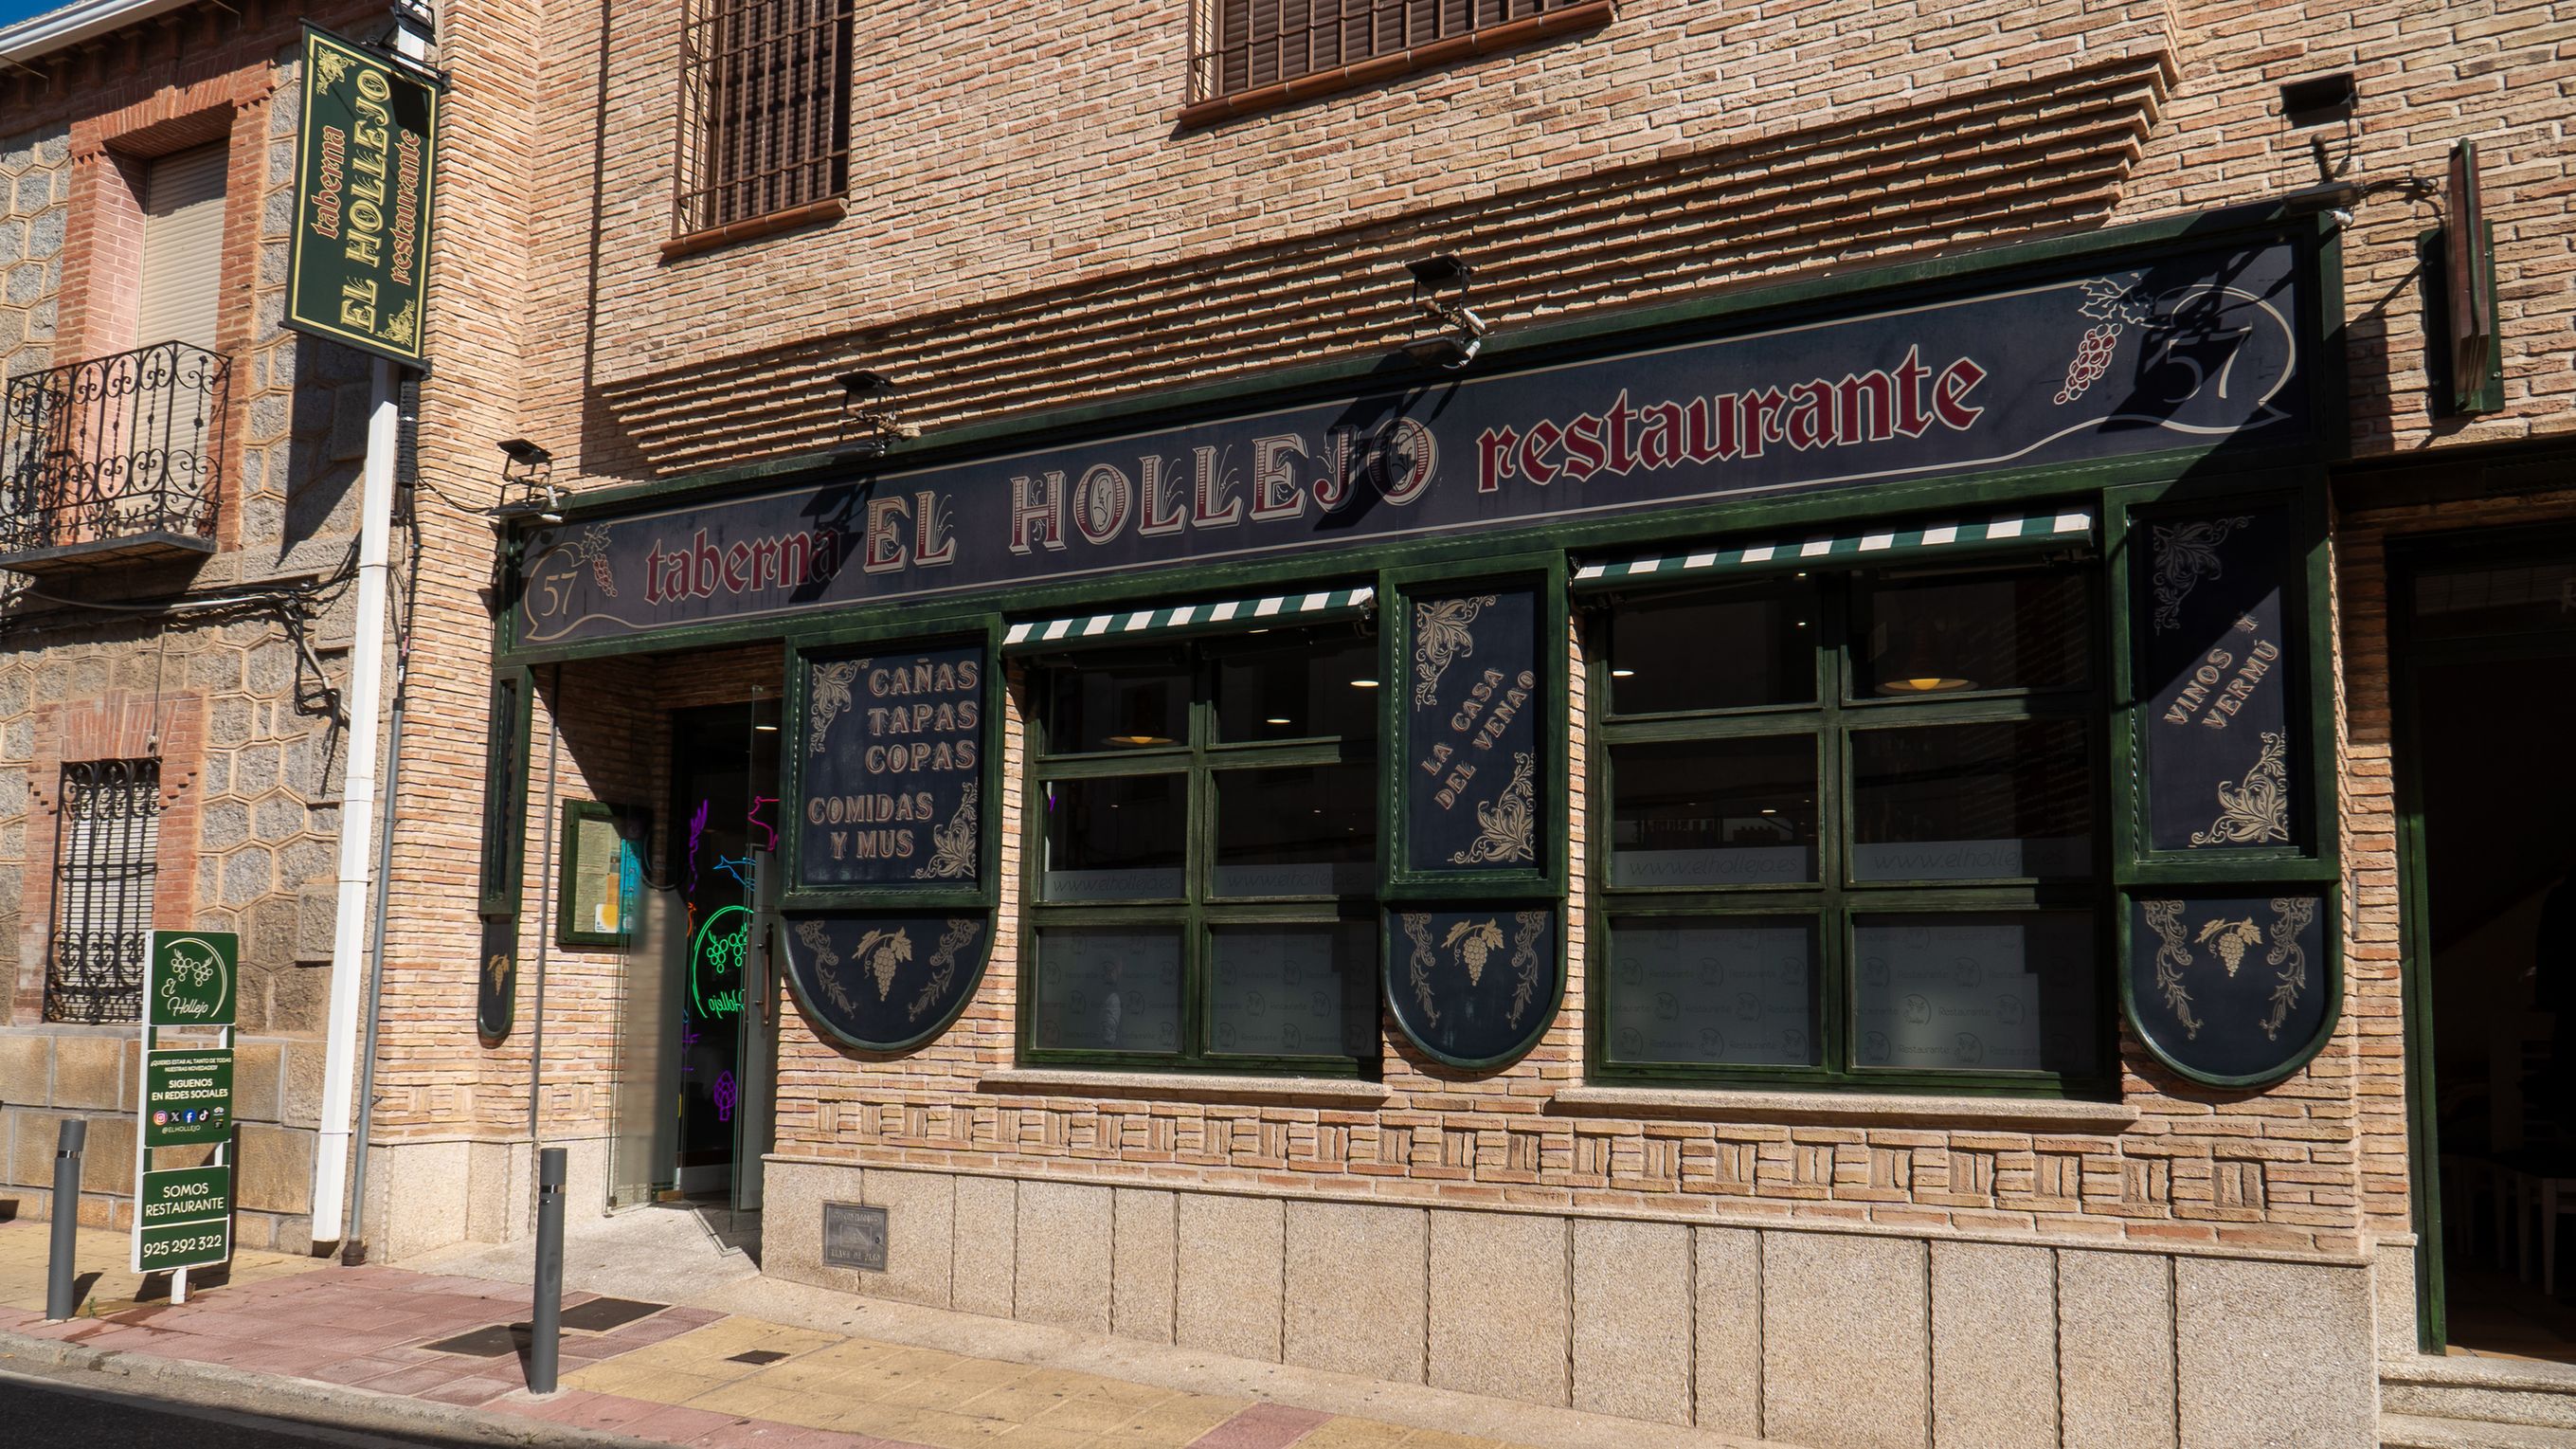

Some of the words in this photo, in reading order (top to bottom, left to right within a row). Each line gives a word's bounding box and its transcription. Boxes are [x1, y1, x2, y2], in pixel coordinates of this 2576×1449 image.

[311, 125, 346, 240] taberna
[345, 69, 391, 268] HOLLEJO
[389, 129, 420, 285] restaurante
[340, 275, 378, 334] EL
[2161, 325, 2254, 404] 57
[644, 527, 841, 606] taberna
[863, 490, 958, 574] EL
[1009, 416, 1439, 555] HOLLEJO
[1477, 343, 1987, 495] restaurante
[541, 571, 577, 617] 57
[868, 658, 979, 697] CAÑAS
[2164, 647, 2233, 725] VINOS
[2233, 611, 2260, 634] Y
[2202, 639, 2280, 730] VERMÚ
[867, 699, 979, 736] TAPAS
[1422, 742, 1453, 776] LA
[1451, 667, 1504, 732] CASA
[866, 739, 977, 773] COPAS
[1434, 760, 1476, 810] DEL
[1472, 670, 1536, 751] VENAO
[807, 791, 934, 824] COMIDAS
[830, 831, 848, 860] Y
[856, 829, 915, 859] MUS
[1630, 852, 1797, 878] www.elhollejo.es
[160, 978, 176, 998] El
[167, 997, 208, 1019] Hollejo
[152, 1092, 163, 1101] EN
[165, 1091, 189, 1100] REDES
[190, 1089, 228, 1099] SOCIALES
[169, 1078, 213, 1089] SIGUENOS
[161, 1125, 201, 1134] @ELHOLLEJO
[145, 1197, 225, 1217] RESTAURANTE
[163, 1183, 208, 1198] SOMOS
[143, 1241, 170, 1258] 925
[171, 1238, 196, 1253] 292
[198, 1235, 222, 1250] 322
